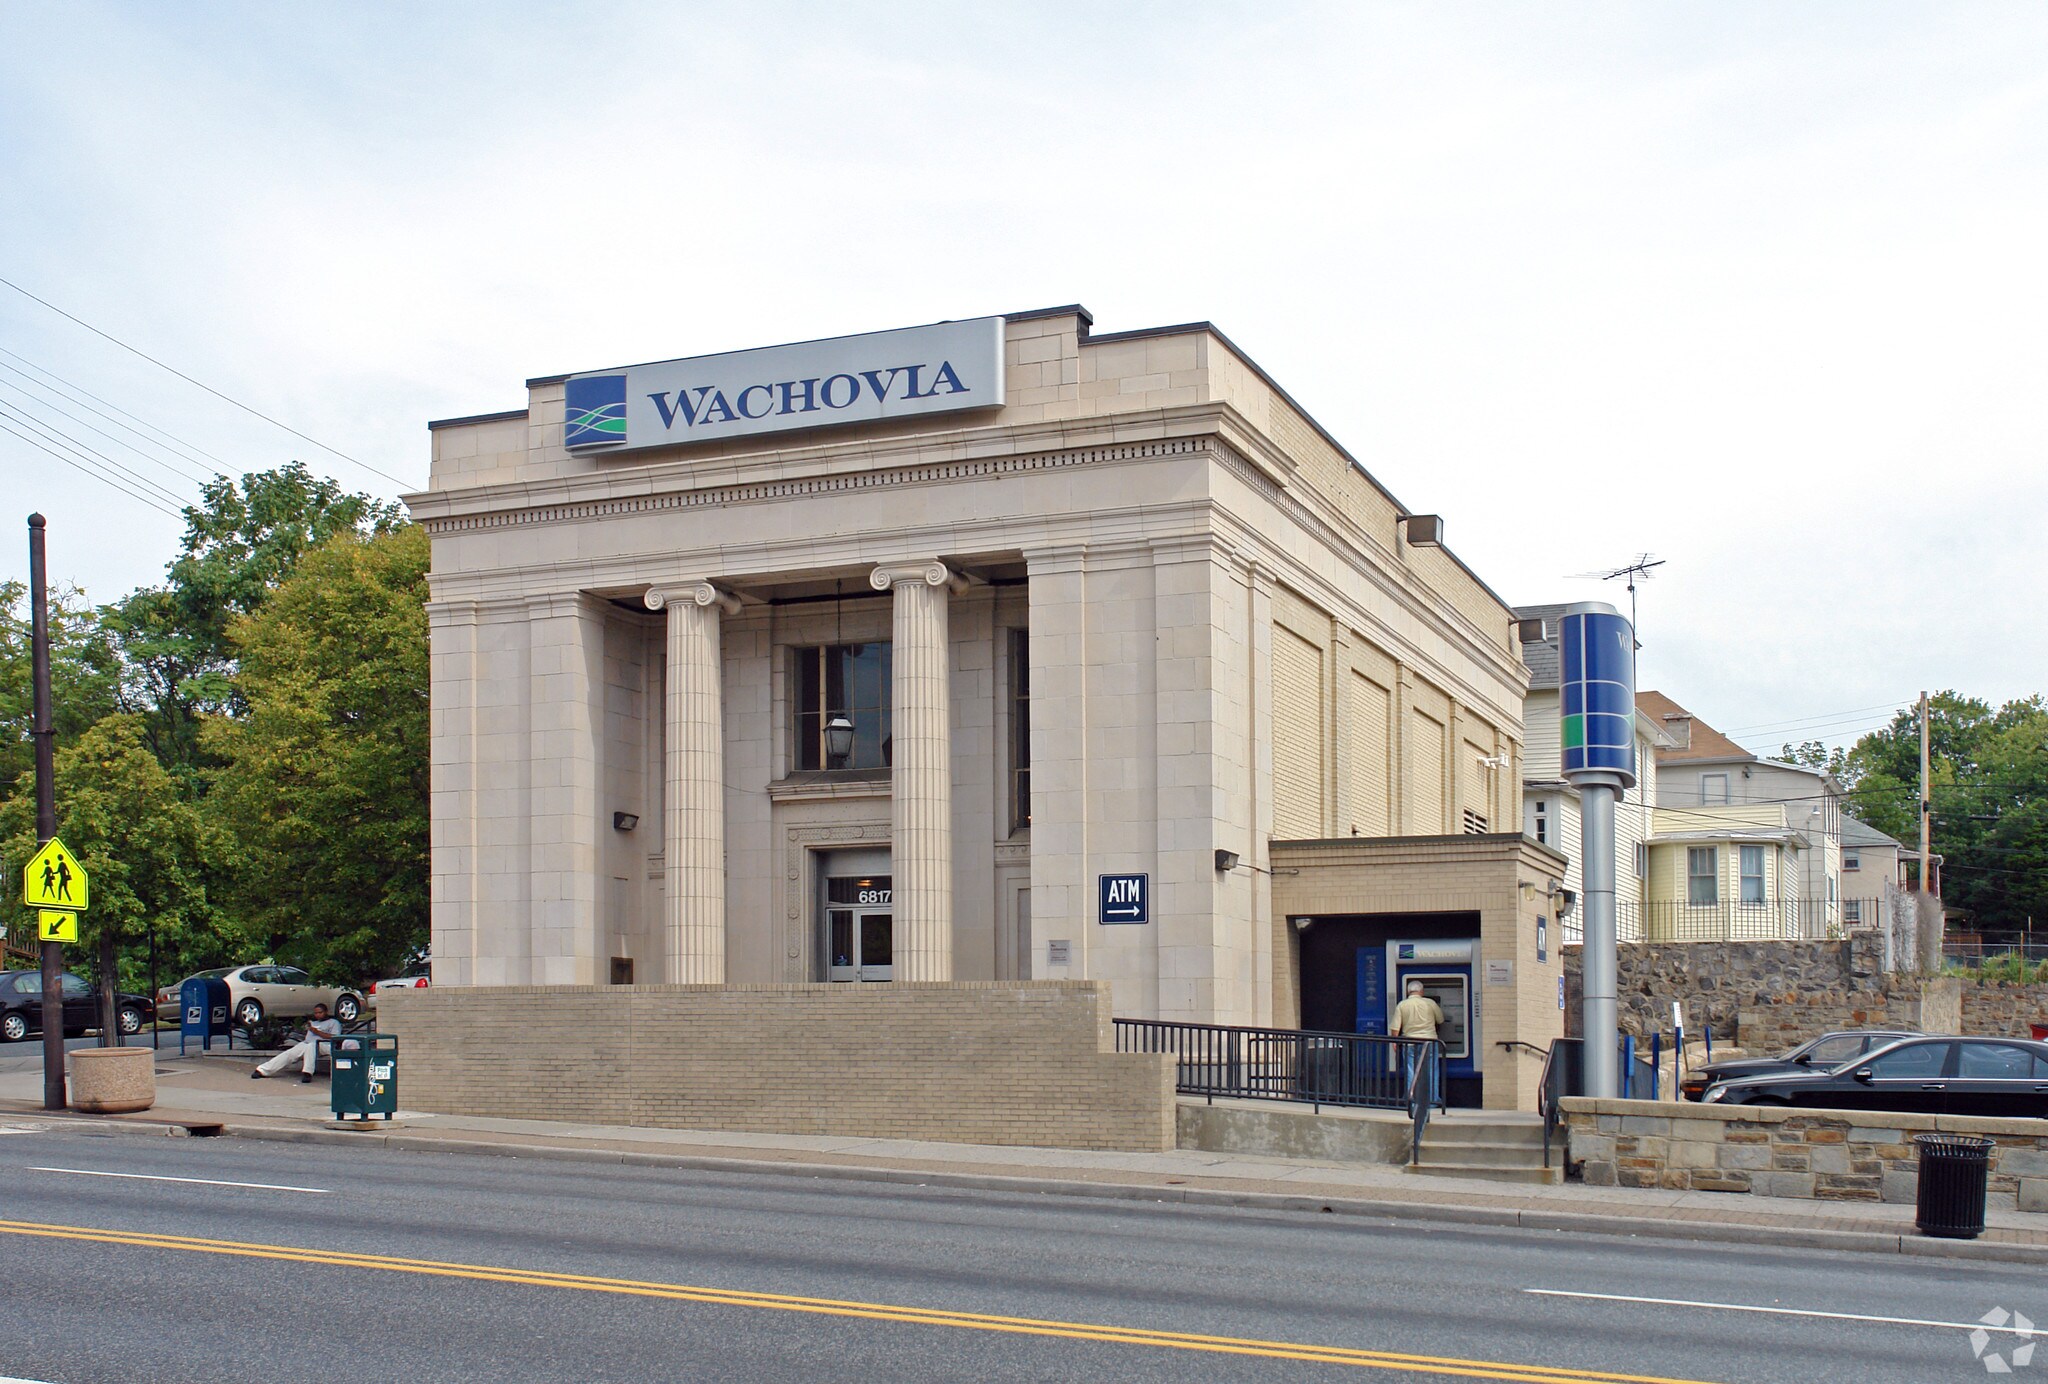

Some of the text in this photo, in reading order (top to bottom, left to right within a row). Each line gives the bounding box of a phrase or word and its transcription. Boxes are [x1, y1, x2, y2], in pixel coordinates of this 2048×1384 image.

[647, 360, 971, 430] WACHOVIA
[859, 890, 892, 903] 6817
[1108, 879, 1140, 903] ATM
